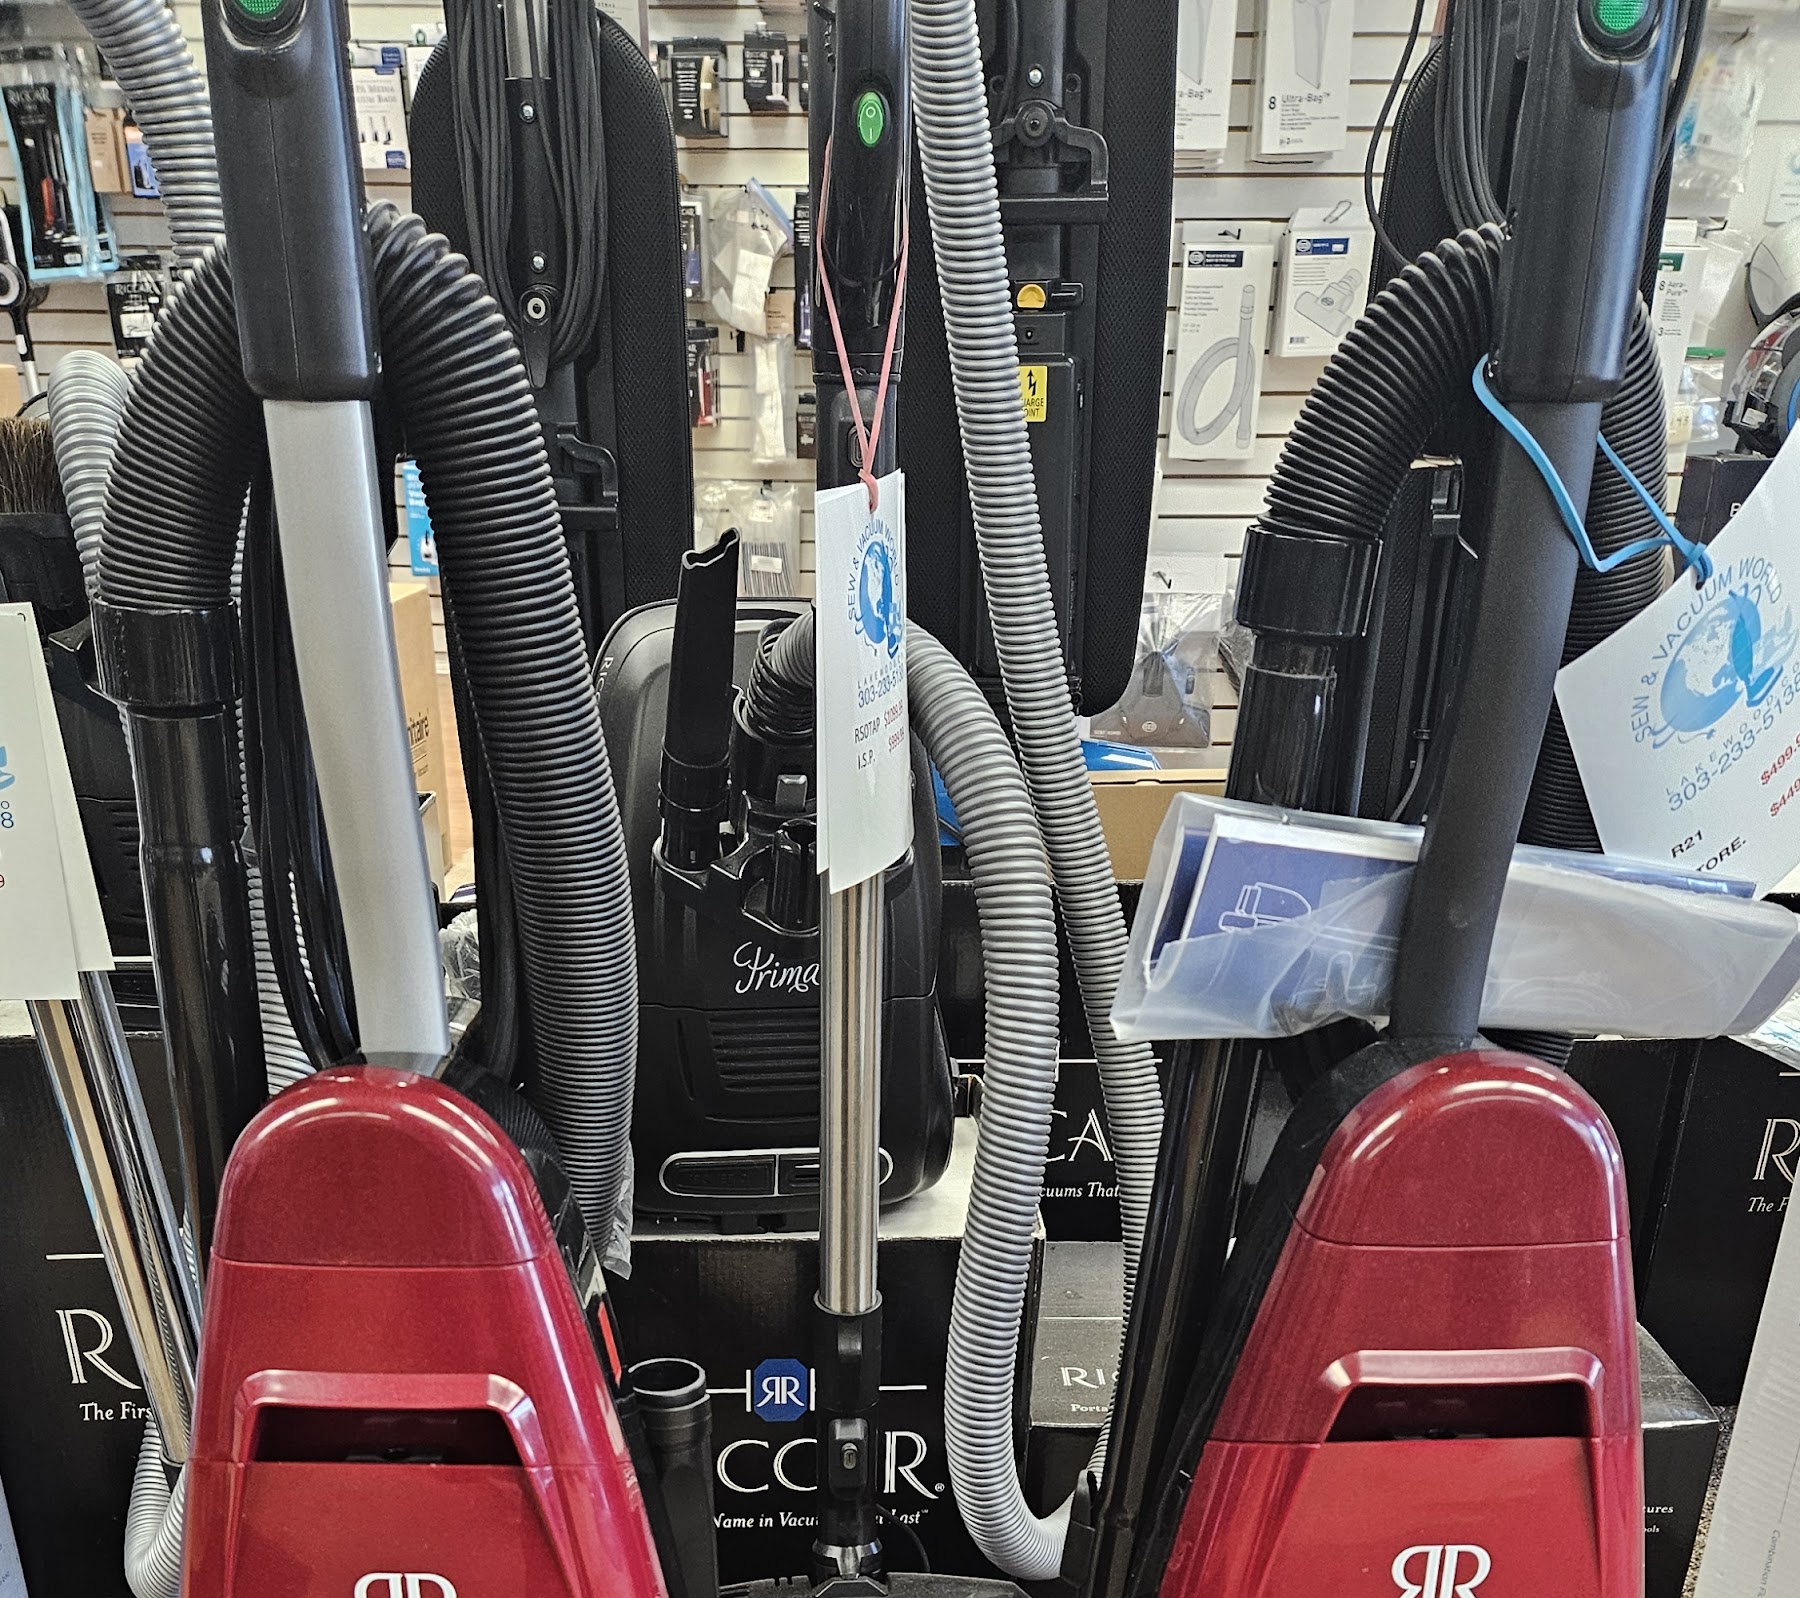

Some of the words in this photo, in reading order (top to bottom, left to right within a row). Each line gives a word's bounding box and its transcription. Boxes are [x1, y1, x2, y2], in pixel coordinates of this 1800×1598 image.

[1269, 96, 1276, 110] 8
[848, 573, 856, 621] SEW
[1631, 696, 1651, 743] SEW
[1641, 671, 1660, 686] &
[1652, 565, 1733, 661] VACUUM
[1739, 556, 1782, 604] WORLD
[1671, 830, 1703, 859] R21
[733, 941, 819, 994] Prima
[1748, 1196, 1774, 1213] The
[79, 1401, 114, 1421] The
[759, 1513, 774, 1528] in
